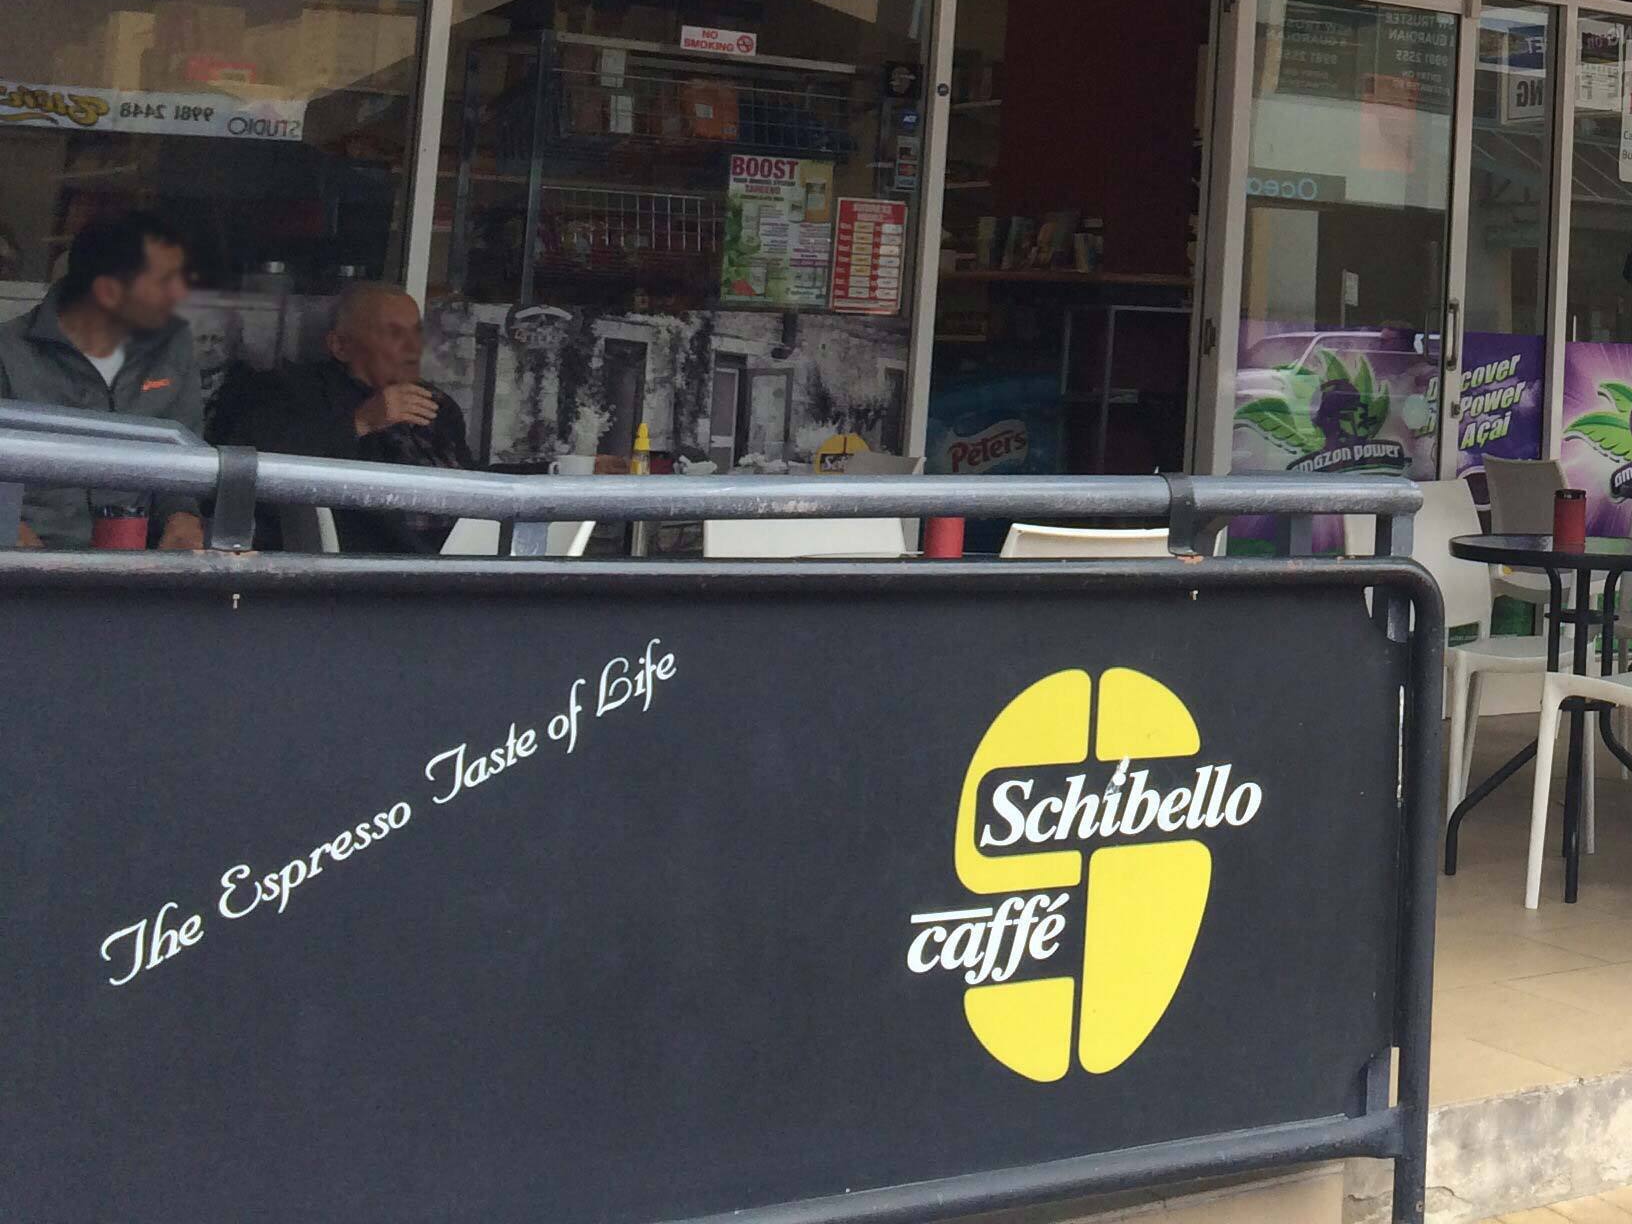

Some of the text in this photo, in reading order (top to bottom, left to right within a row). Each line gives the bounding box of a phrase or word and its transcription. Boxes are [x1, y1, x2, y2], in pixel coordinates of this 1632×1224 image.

[684, 38, 735, 52] SMOKING
[702, 29, 718, 39] NO
[731, 155, 799, 179] BOOST
[1459, 411, 1512, 450] Açai
[949, 429, 1026, 473] Peters
[1353, 444, 1400, 461] power
[101, 638, 677, 986] The Espresso Taste of Life
[979, 761, 1262, 848] Schibello
[907, 892, 1070, 985] caffé
